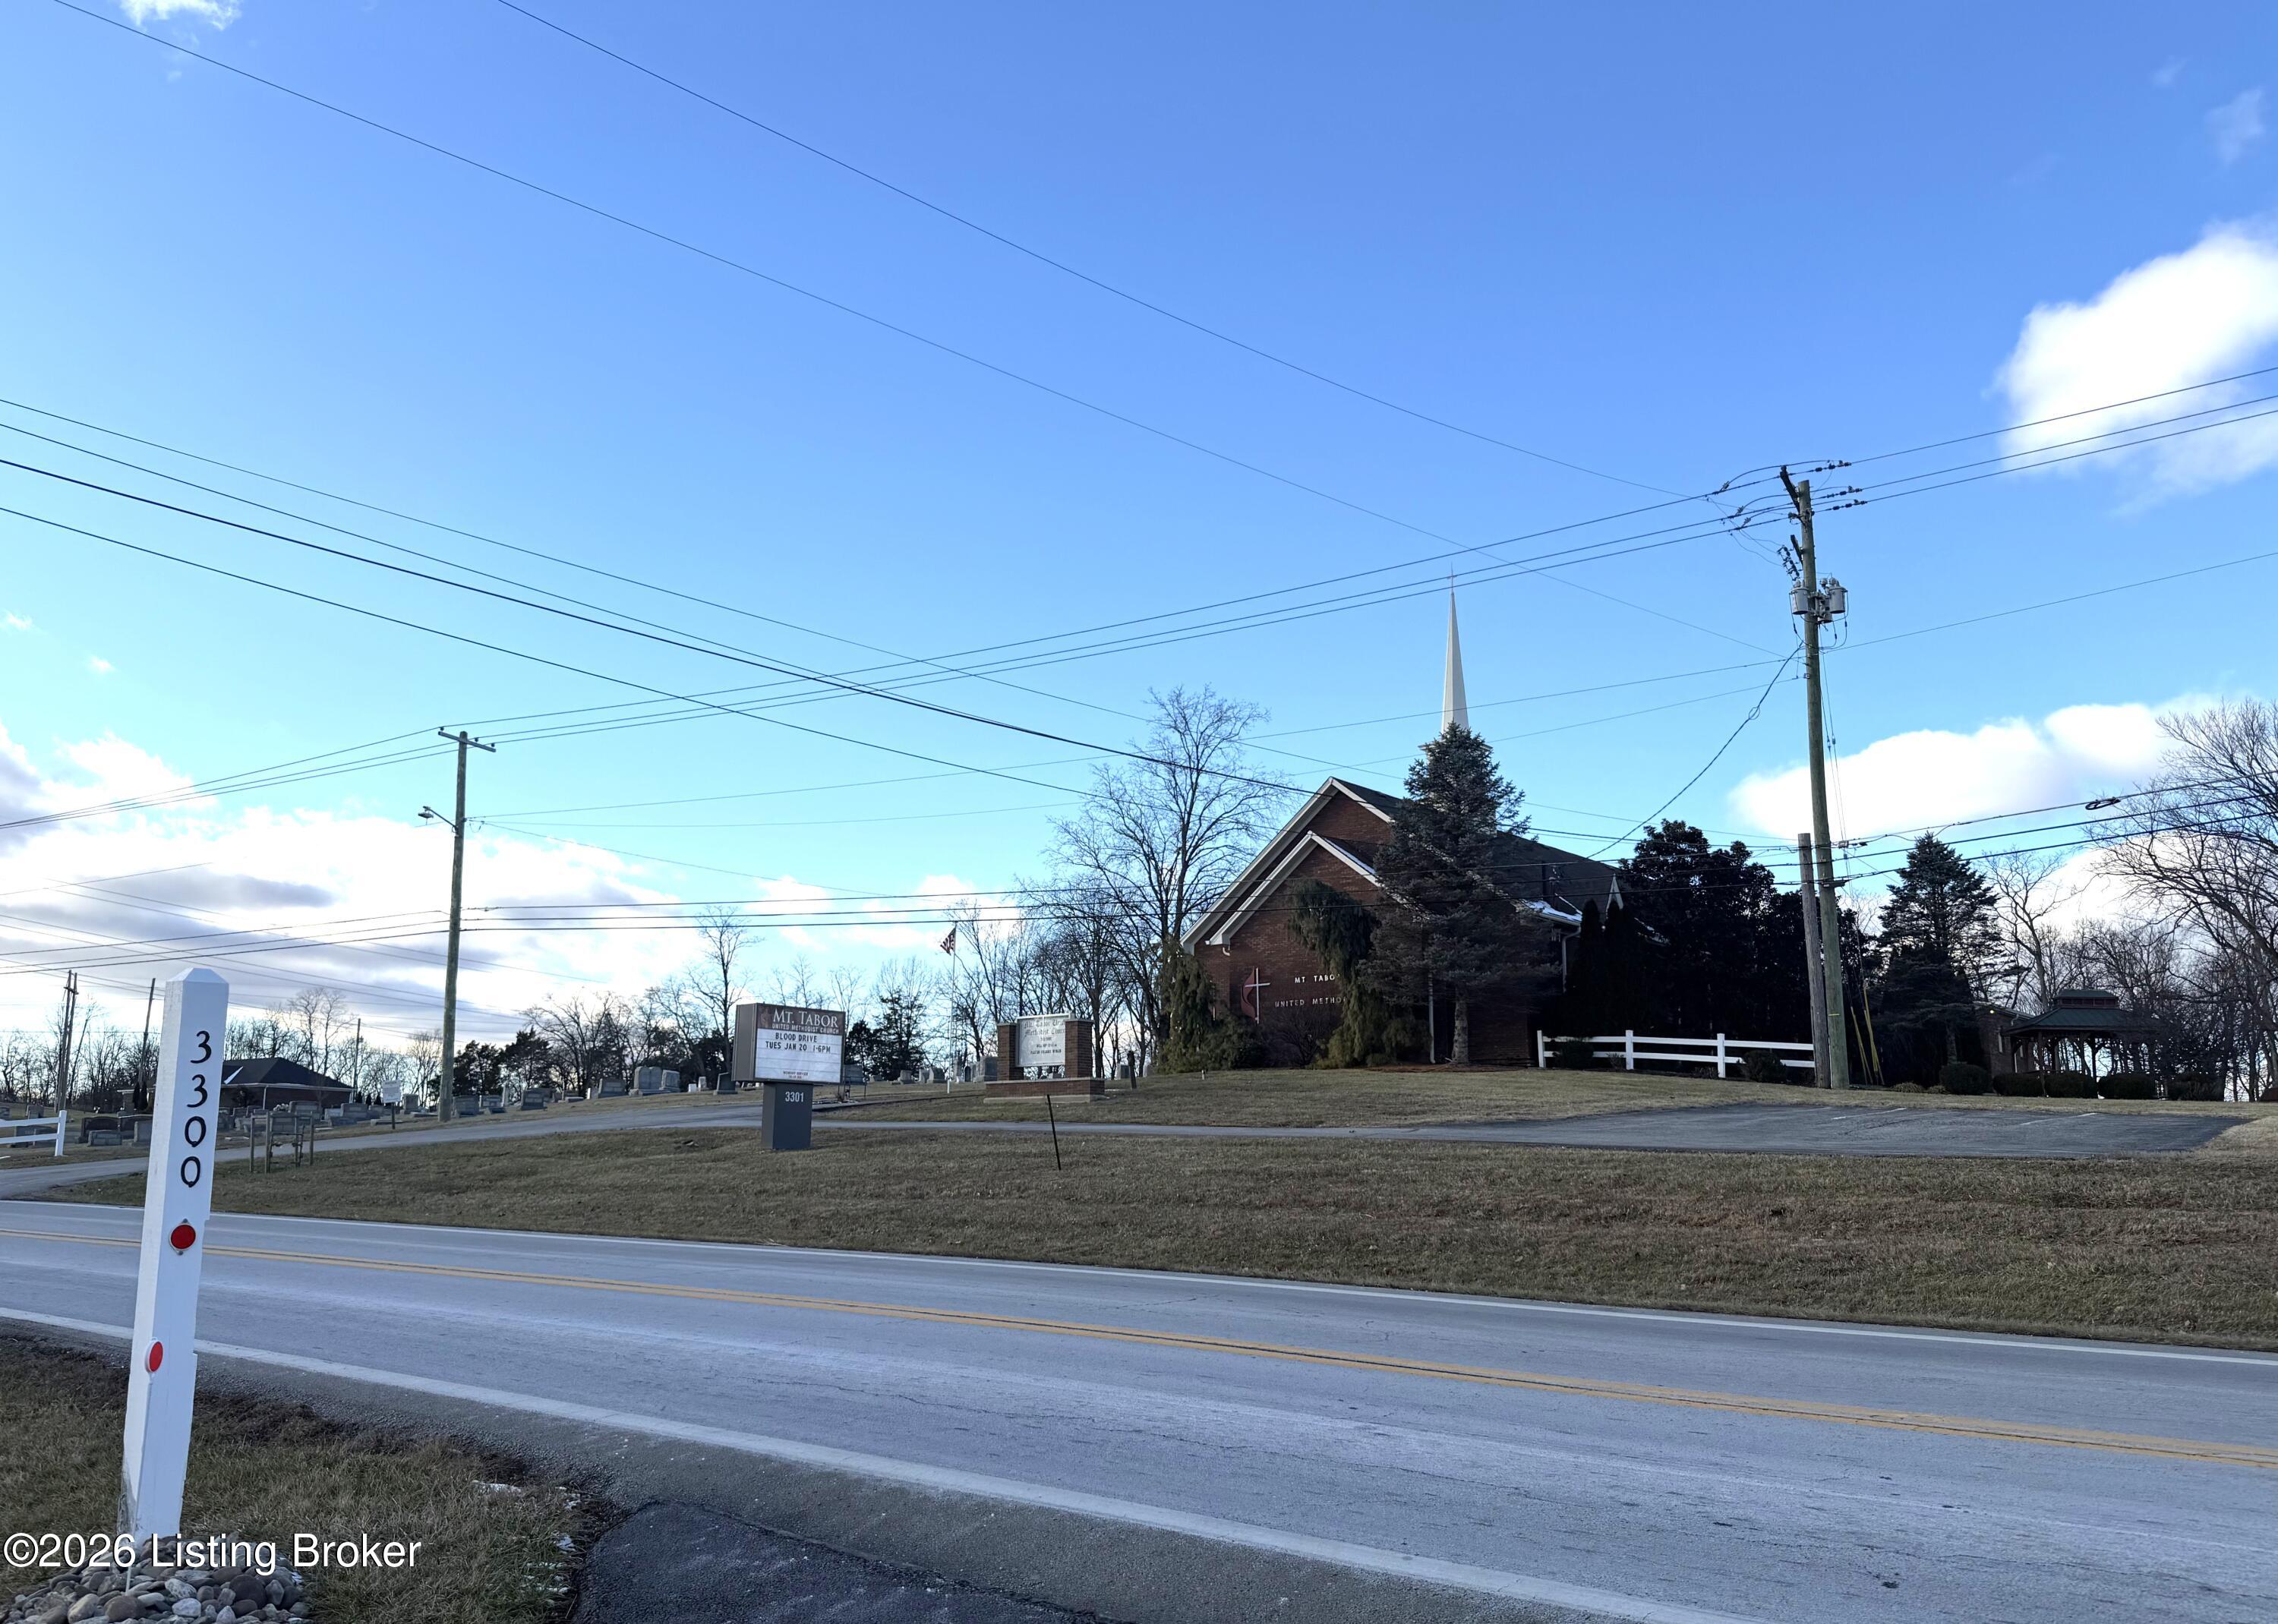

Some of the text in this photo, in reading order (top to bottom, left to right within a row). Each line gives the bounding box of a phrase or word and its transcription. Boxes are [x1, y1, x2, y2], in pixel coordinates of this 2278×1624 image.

[1314, 974, 1340, 982] TABO
[1276, 996, 1346, 1008] UNITED METHO
[773, 1008, 794, 1023] MT.
[791, 1025, 818, 1033] METHODIST
[820, 1026, 839, 1035] CHURCH
[775, 1032, 818, 1043] BLOOD DRIVE
[765, 1041, 781, 1049] TUES
[784, 1042, 797, 1051] JAN
[799, 1043, 807, 1052] 20
[785, 1091, 804, 1102] 3301
[181, 1030, 212, 1188] 3300
